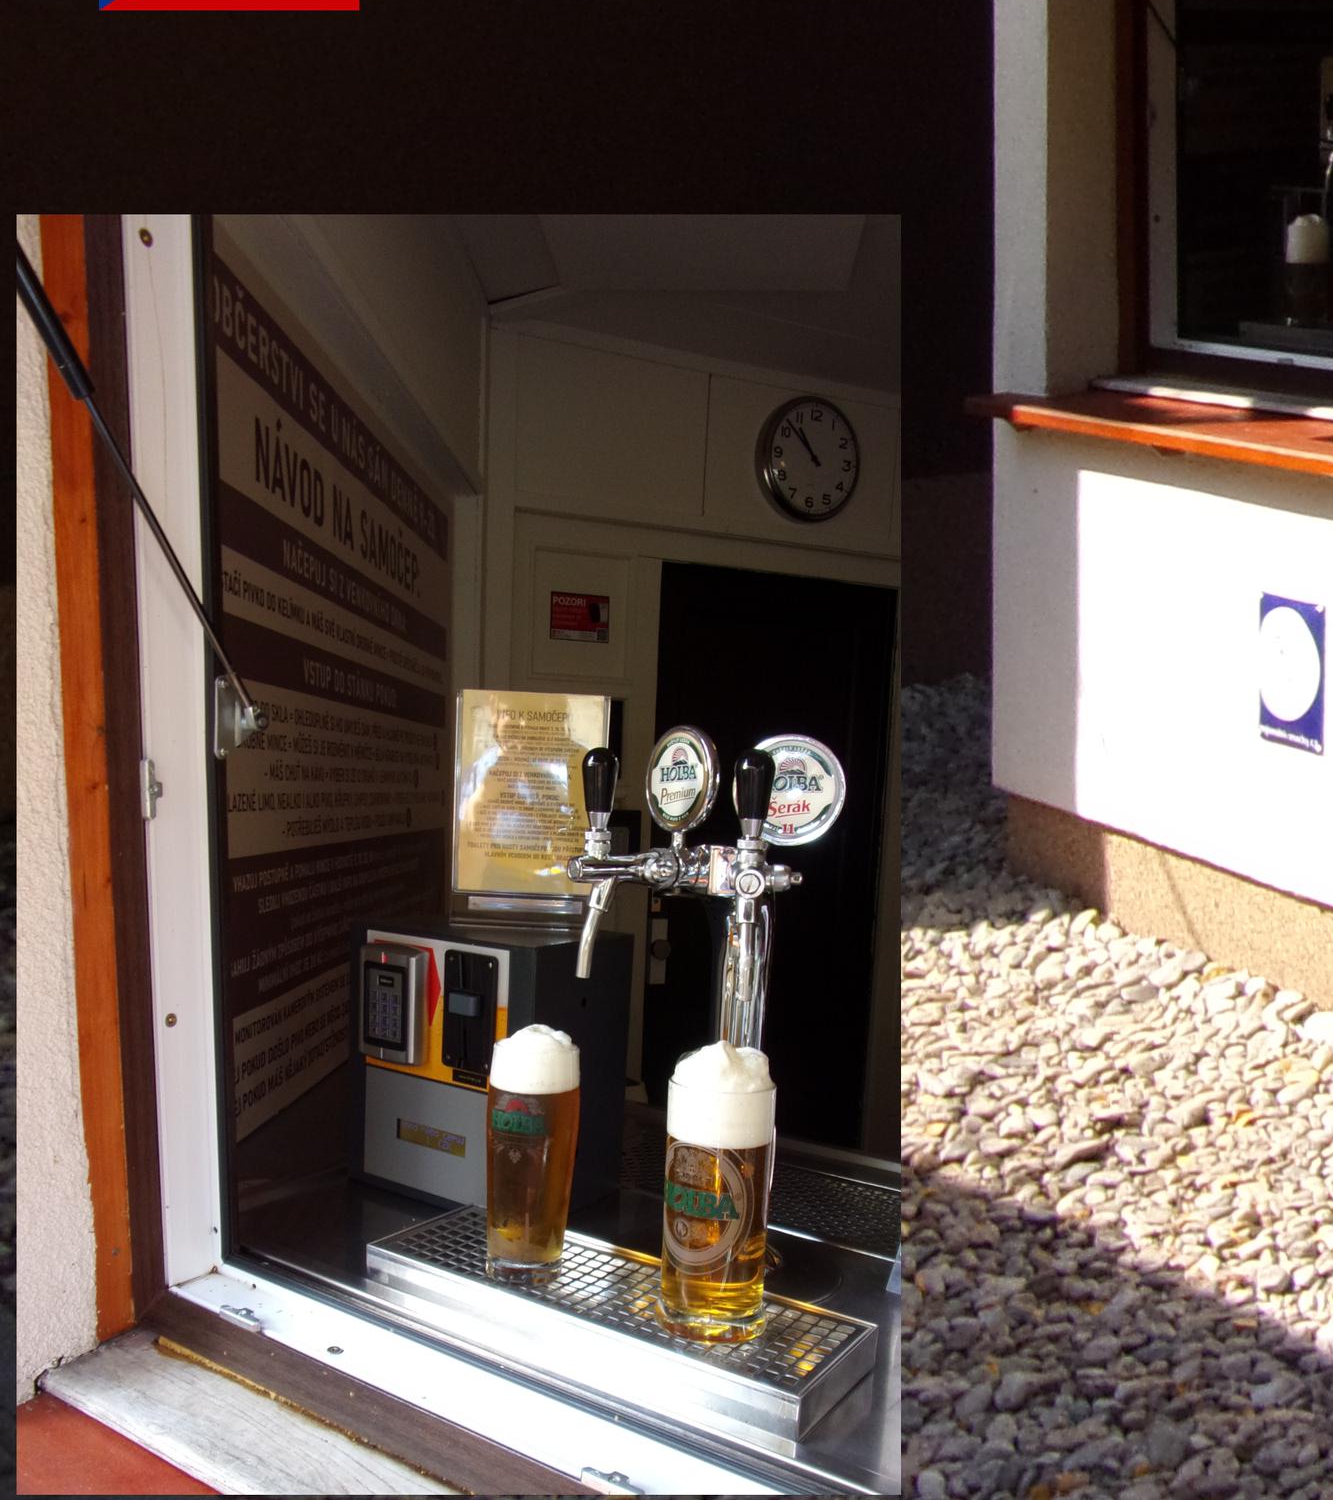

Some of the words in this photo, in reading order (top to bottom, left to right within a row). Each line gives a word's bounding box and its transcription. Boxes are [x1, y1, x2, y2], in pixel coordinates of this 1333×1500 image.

[253, 414, 325, 528] NÁVOD
[332, 482, 354, 551] NA
[660, 765, 697, 782] HOLBA
[771, 775, 823, 793] OLBA
[660, 787, 696, 806] Premium
[767, 796, 811, 818] Šerák
[781, 823, 795, 835] 11
